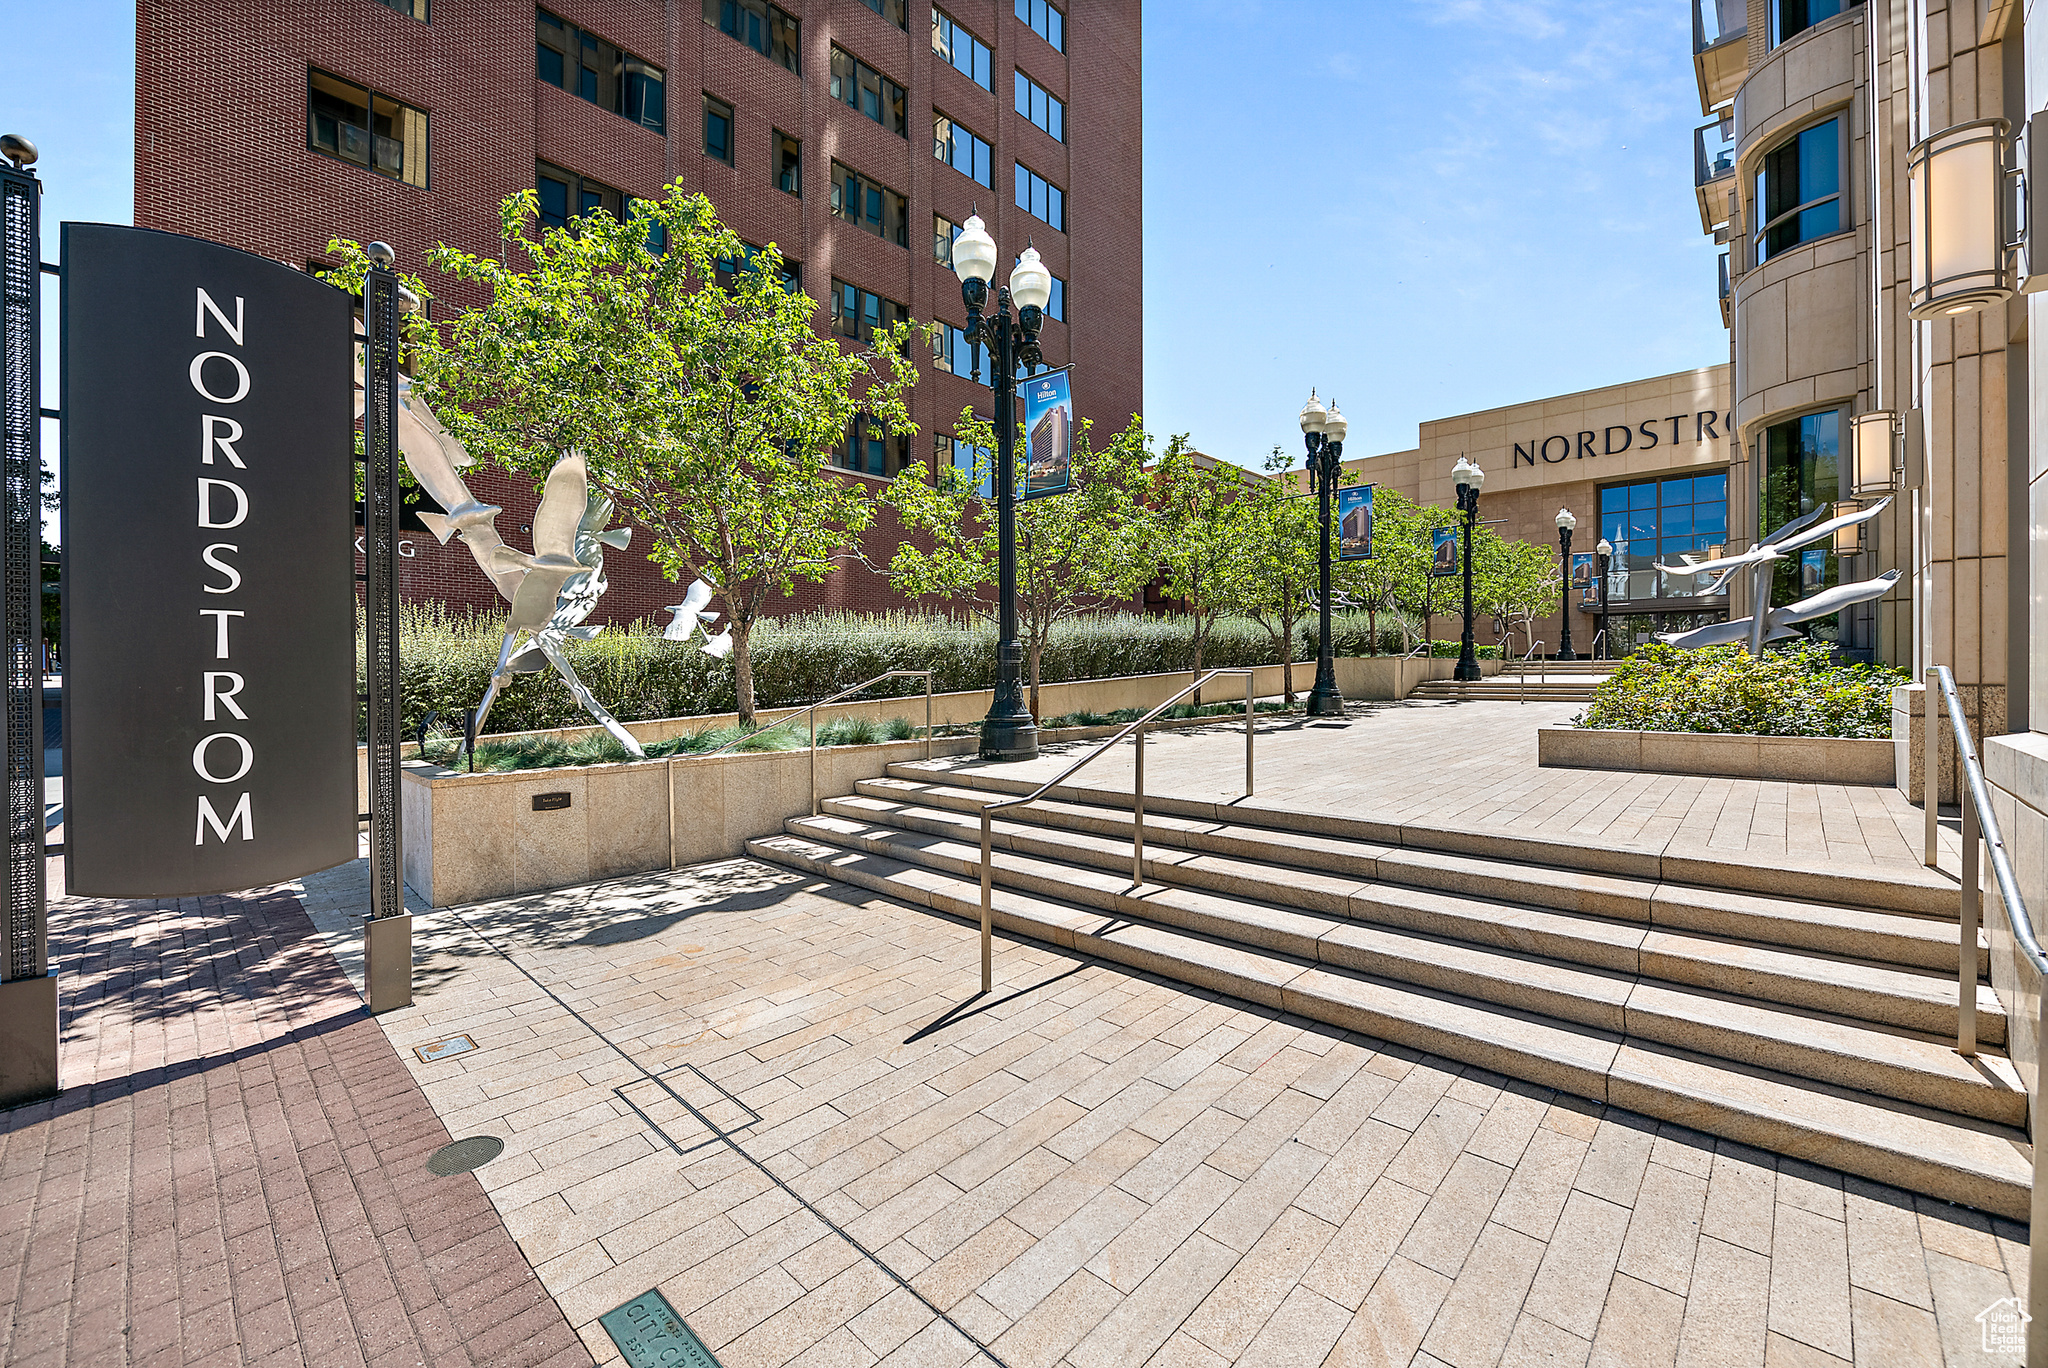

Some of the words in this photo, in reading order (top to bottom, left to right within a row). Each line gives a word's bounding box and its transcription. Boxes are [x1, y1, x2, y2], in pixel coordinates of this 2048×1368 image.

[1037, 390, 1057, 400] Hilton
[1513, 410, 1730, 469] NORDSTR
[188, 286, 255, 847] NORDSTROM
[626, 1304, 667, 1343] CITY
[626, 1338, 647, 1362] EST.
